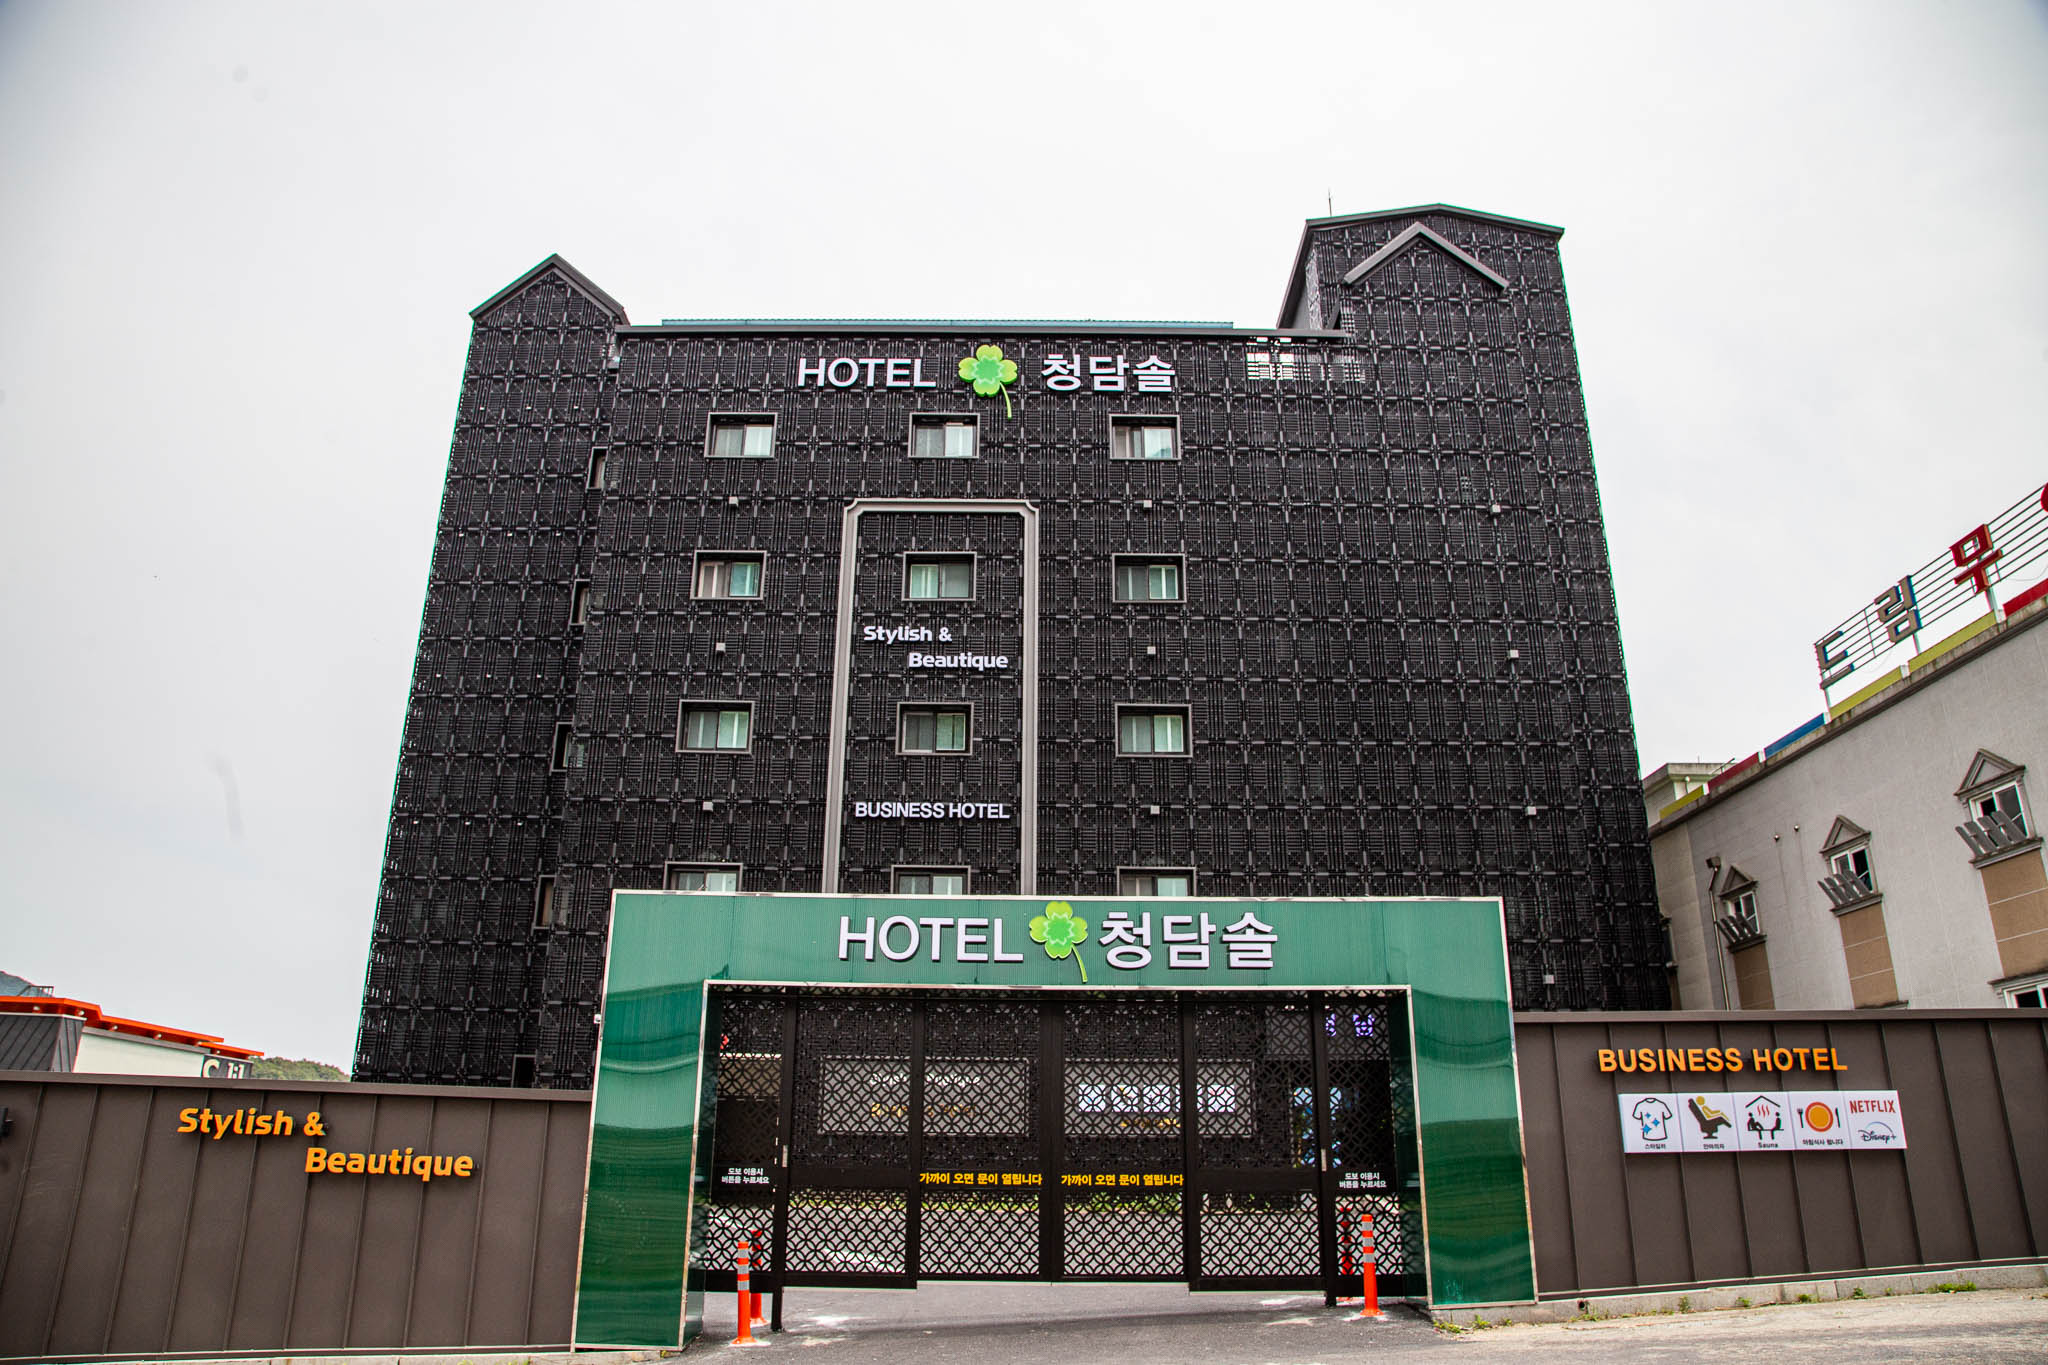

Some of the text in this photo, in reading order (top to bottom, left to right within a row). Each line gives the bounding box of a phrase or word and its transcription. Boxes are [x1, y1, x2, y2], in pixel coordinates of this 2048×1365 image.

[798, 353, 1176, 393] HOTEL 청담솔
[863, 626, 953, 645] Stylish &
[908, 652, 1009, 671] Beautique
[855, 801, 1010, 819] BUSINESS HOTEL
[838, 911, 1279, 969] HOTEL 청담솔
[1598, 1047, 1849, 1073] BUSINESS HOTEL
[1850, 1100, 1896, 1114] NETFLIX
[177, 1107, 327, 1140] Stylish &
[305, 1147, 474, 1182] Beautique
[919, 1172, 1043, 1186] 가까이 오면 문이 열립니다
[1061, 1174, 1185, 1187] 가까이 오면 문이 열립니다
